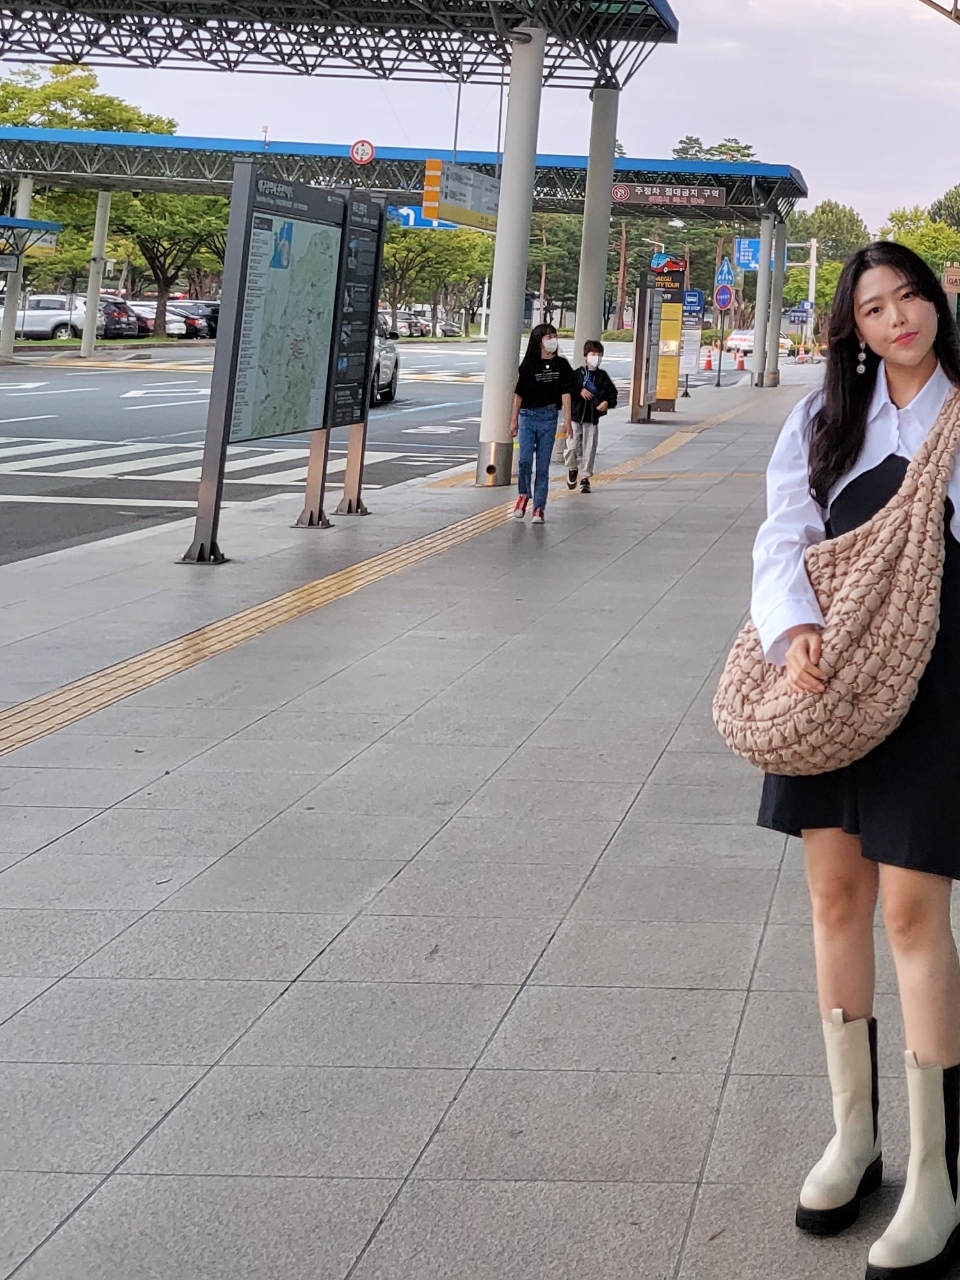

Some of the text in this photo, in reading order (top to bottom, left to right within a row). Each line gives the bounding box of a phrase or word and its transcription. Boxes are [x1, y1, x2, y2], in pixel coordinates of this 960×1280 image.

[634, 186, 720, 199] 주정차 절대금지 구역
